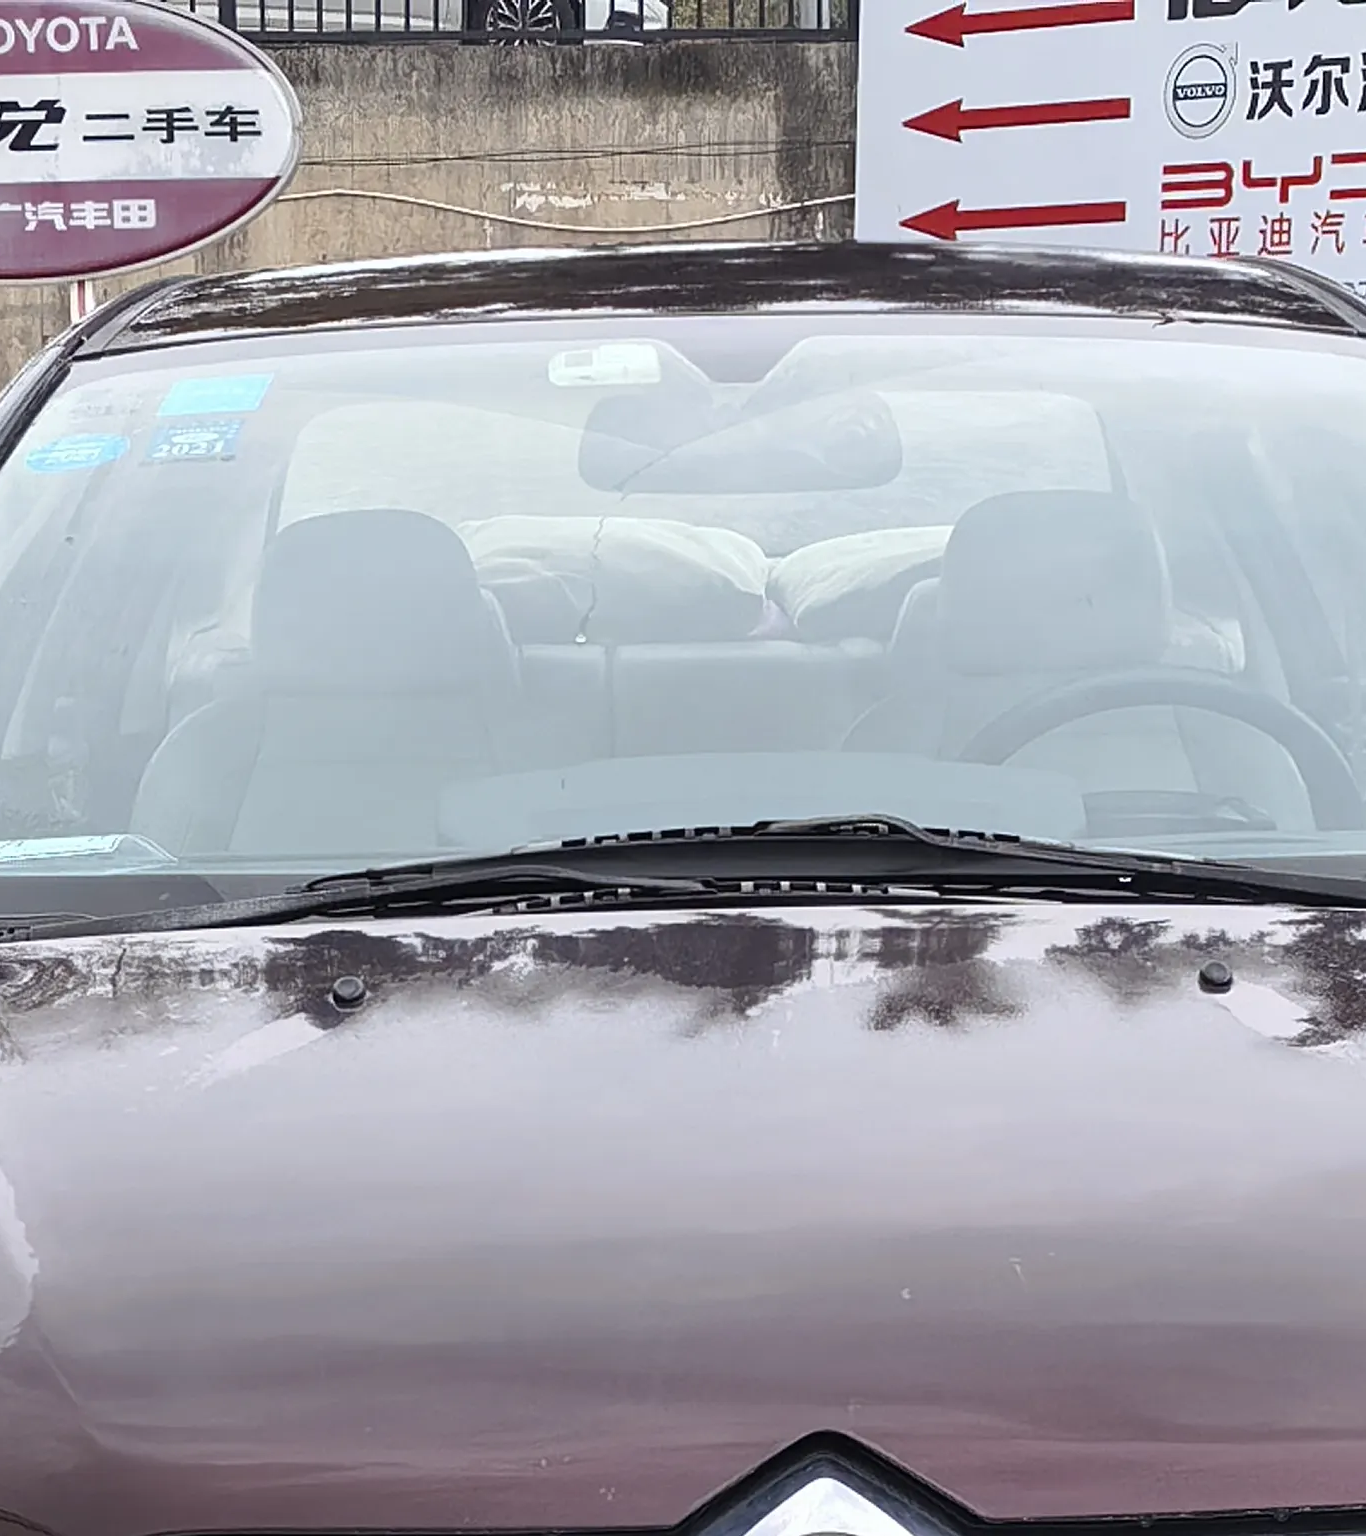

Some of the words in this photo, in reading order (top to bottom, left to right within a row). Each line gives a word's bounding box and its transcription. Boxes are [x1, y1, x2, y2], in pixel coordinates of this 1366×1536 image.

[1175, 84, 1226, 100] VOLVO
[82, 105, 262, 144] 二手车
